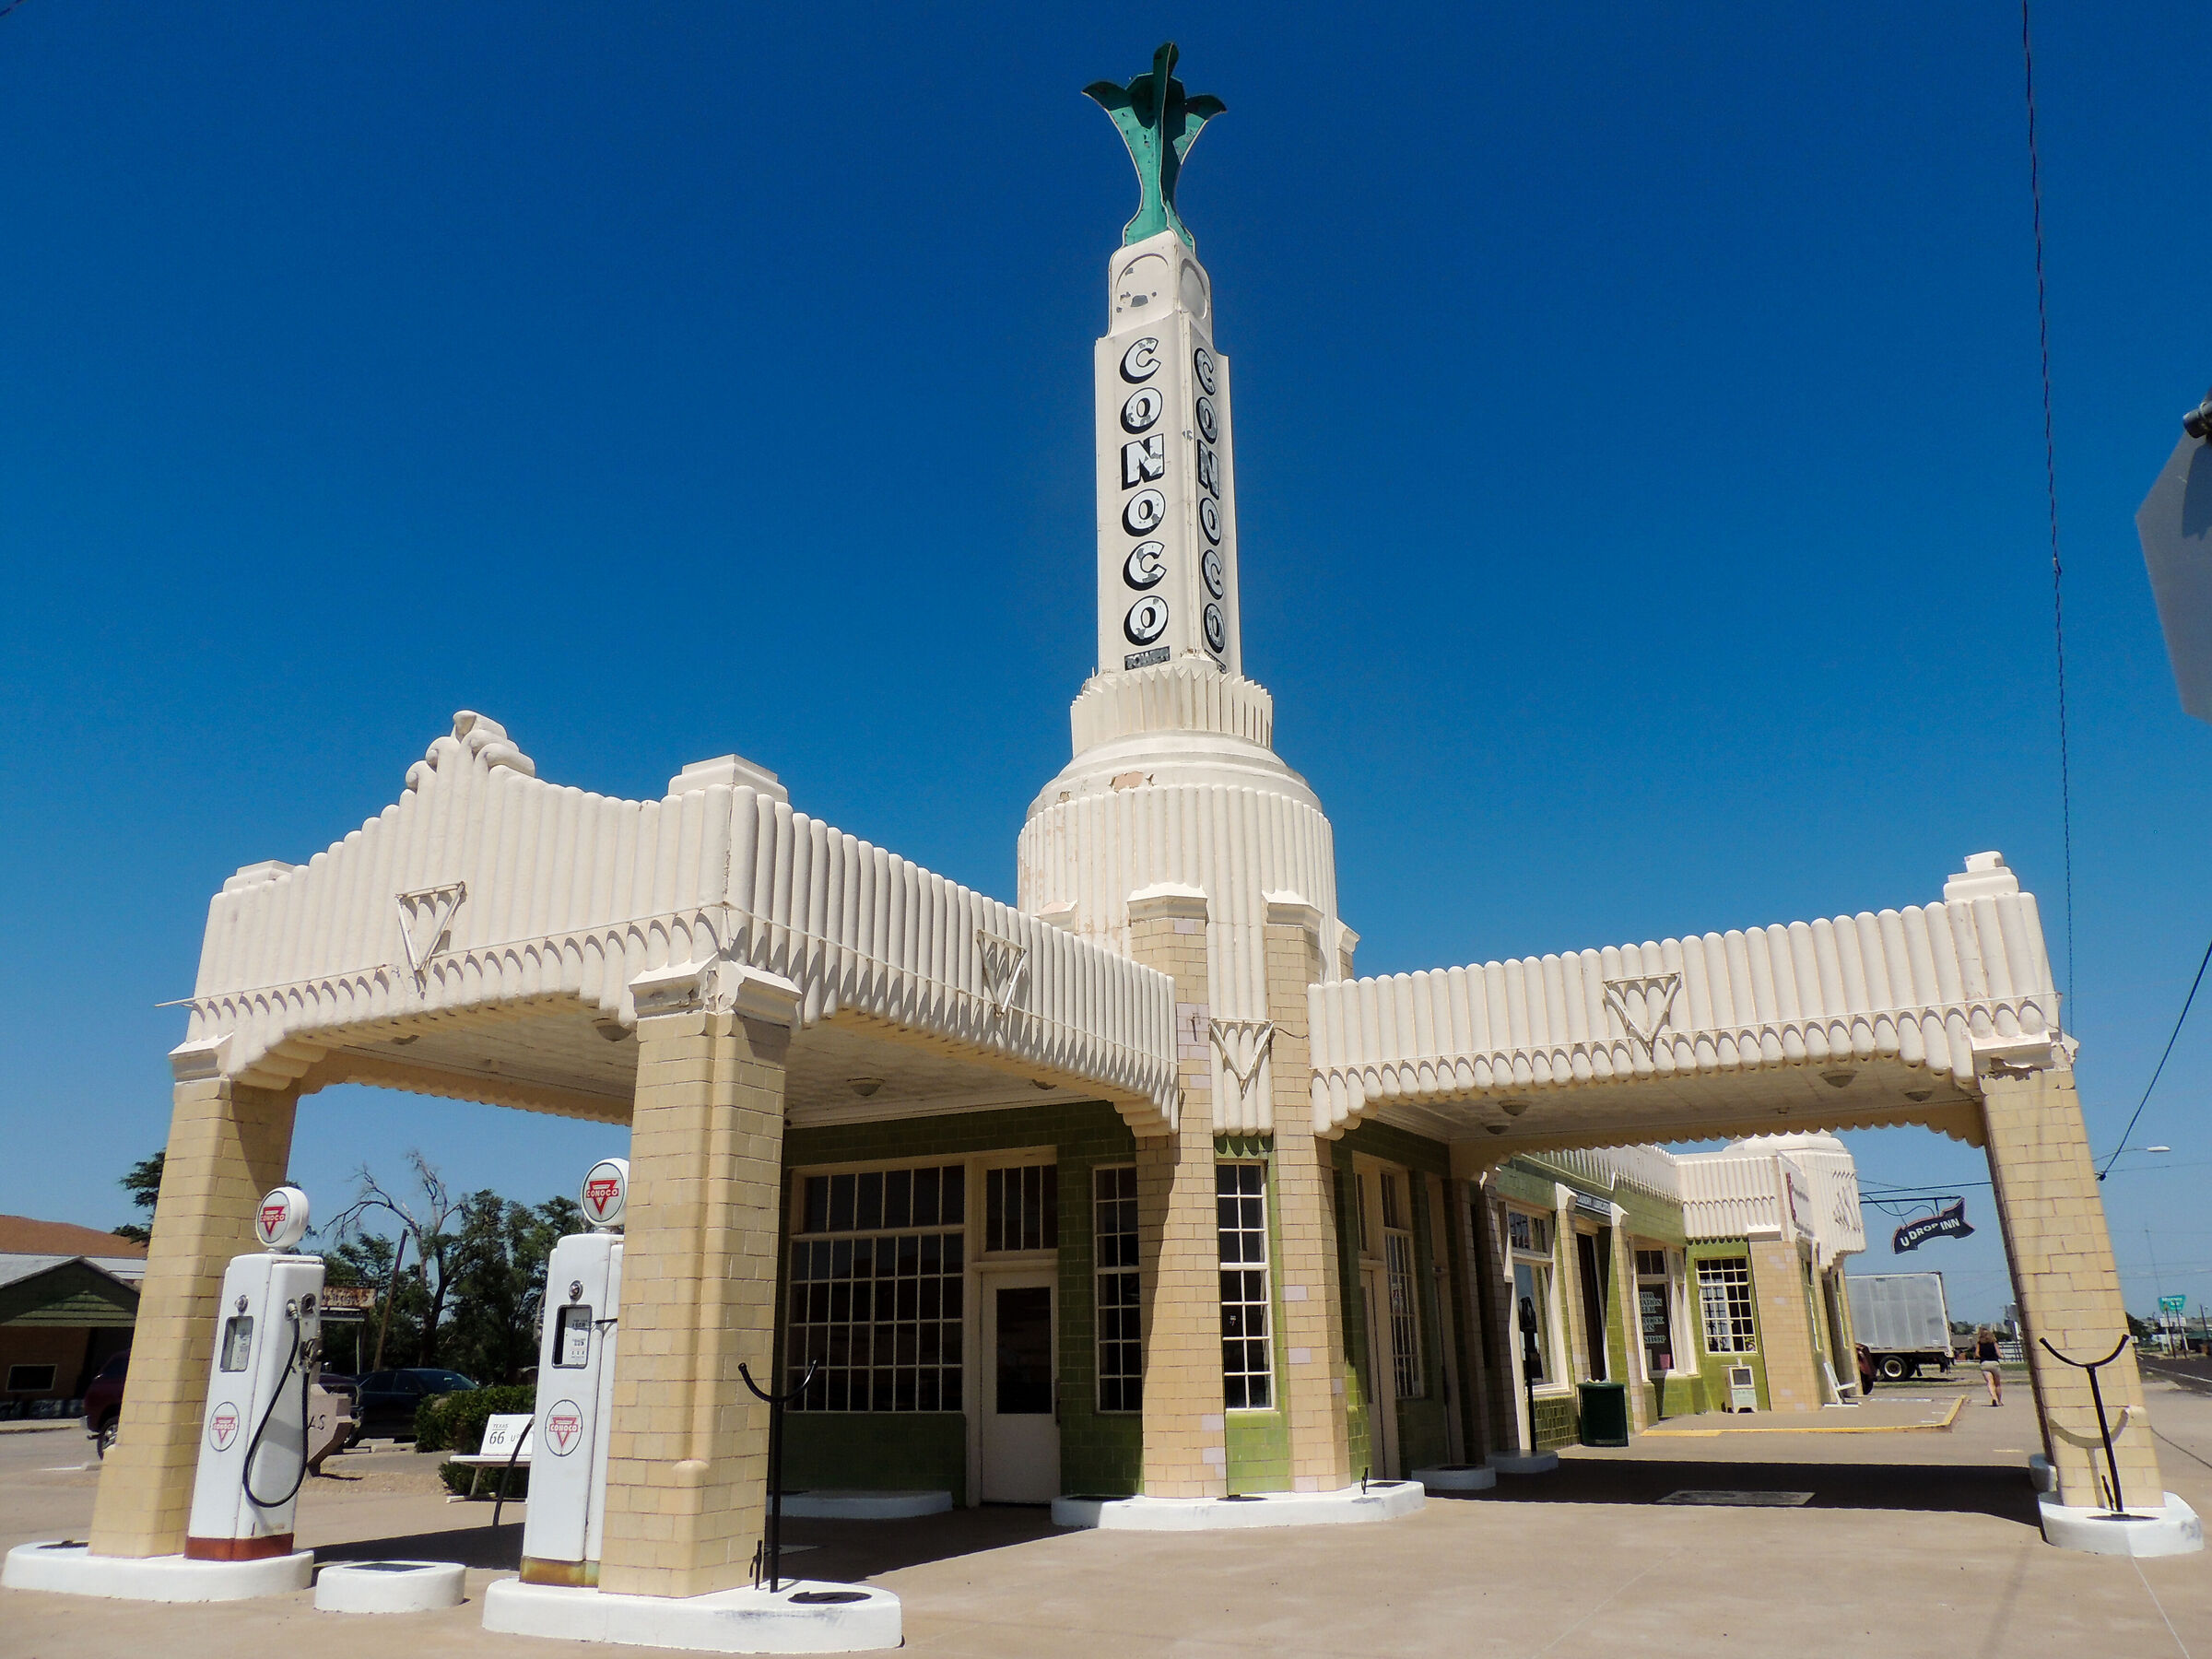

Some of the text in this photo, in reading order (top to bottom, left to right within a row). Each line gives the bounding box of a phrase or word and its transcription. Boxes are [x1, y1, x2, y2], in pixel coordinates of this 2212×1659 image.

[1119, 336, 1169, 647] CONOCO
[1194, 347, 1226, 654] CONOCO
[586, 1189, 618, 1197] CONOCO
[1900, 1218, 1960, 1246] U DROP INN
[489, 1431, 505, 1444] 66
[550, 1424, 578, 1432] CONOCO
